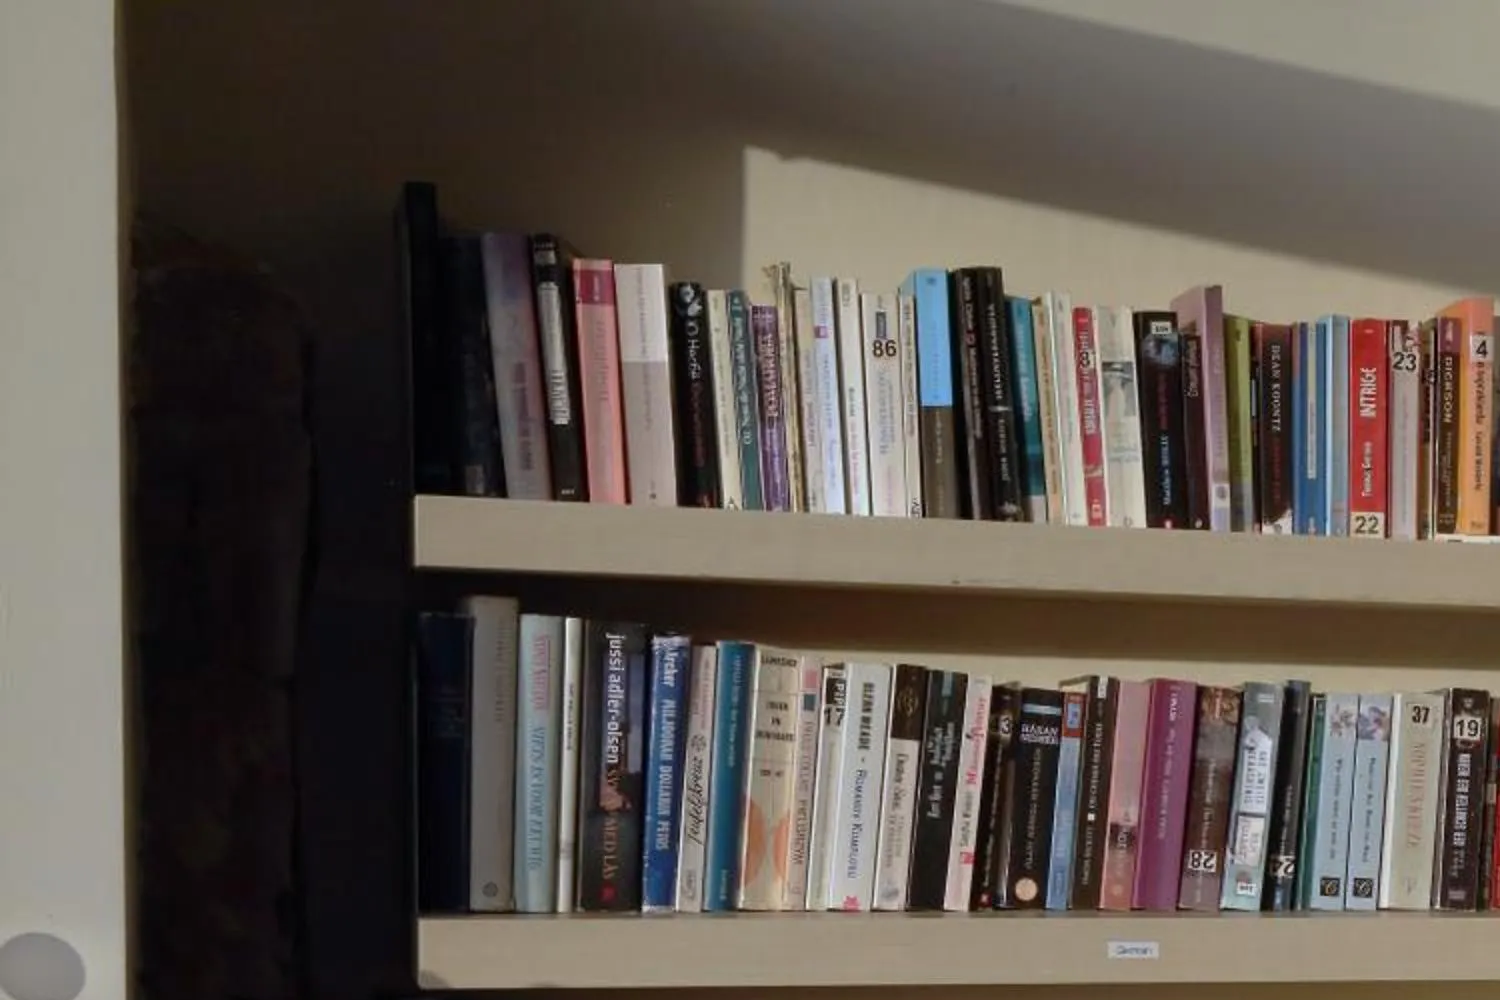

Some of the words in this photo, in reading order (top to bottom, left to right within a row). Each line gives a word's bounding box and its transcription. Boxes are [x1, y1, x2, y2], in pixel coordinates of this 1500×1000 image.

[872, 339, 897, 358] 86
[1475, 340, 1488, 359] 4
[1272, 345, 1280, 377] DEAN
[1391, 352, 1416, 371] 23
[1360, 368, 1376, 417] INTRIGE
[1272, 383, 1280, 431] KOONTZ
[1354, 516, 1379, 535] 22
[605, 633, 625, 671] jussi
[606, 674, 624, 764] adler-olsen
[1411, 705, 1430, 723] 37
[1457, 720, 1478, 737] 19
